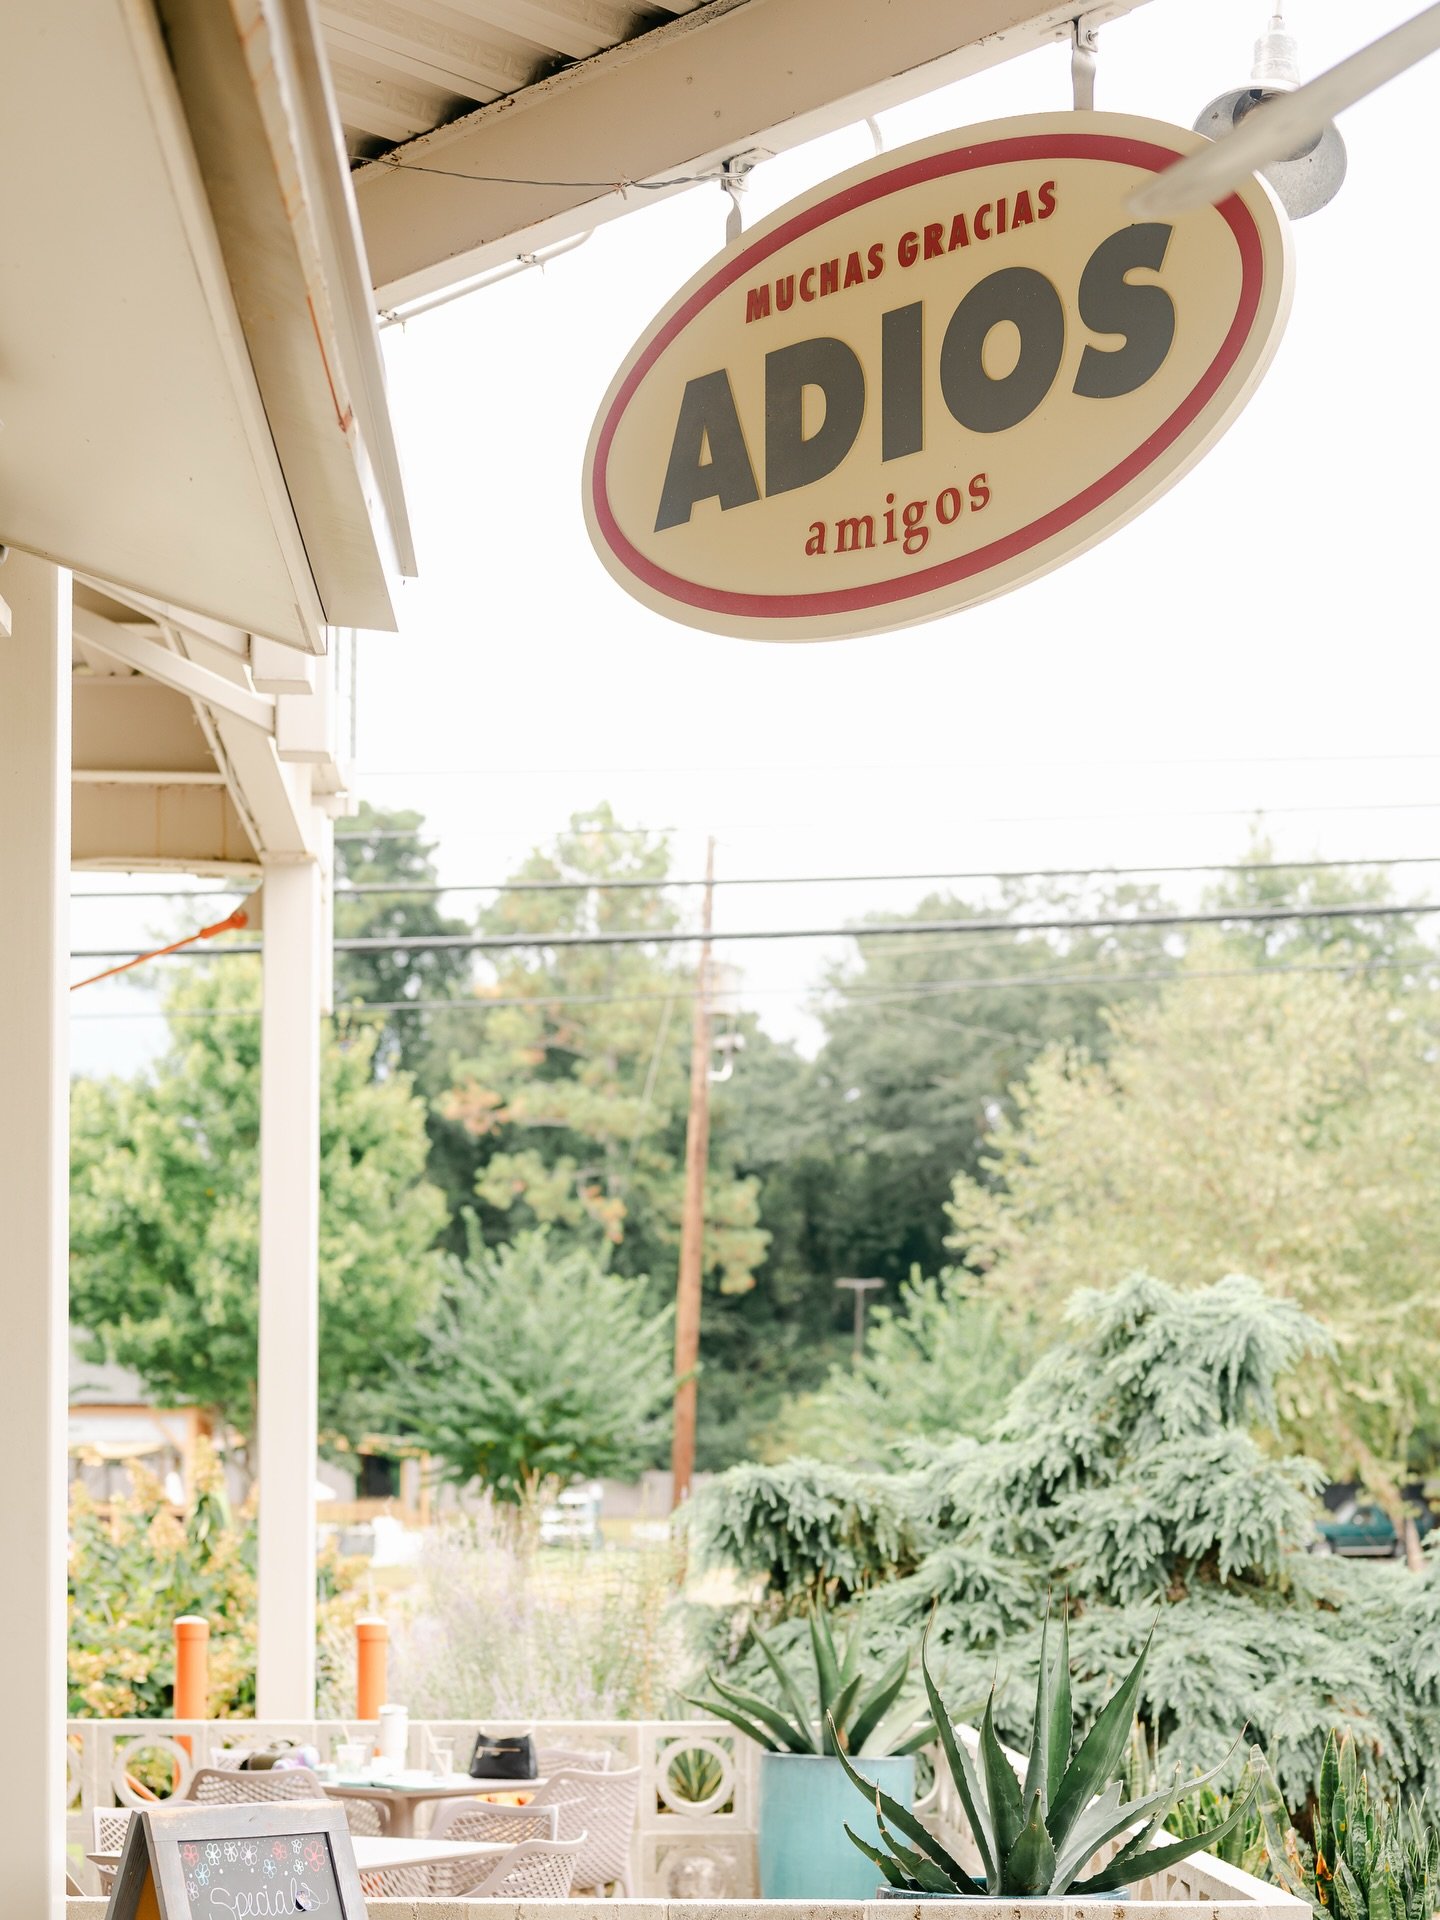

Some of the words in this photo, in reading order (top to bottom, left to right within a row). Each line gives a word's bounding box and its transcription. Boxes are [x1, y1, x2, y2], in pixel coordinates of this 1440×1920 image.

[745, 242, 884, 324] MUCHAS
[897, 180, 1057, 268] GRACIAS
[654, 223, 1176, 533] ADIOS
[804, 472, 991, 557] amigos
[210, 1877, 329, 1920] Specials
